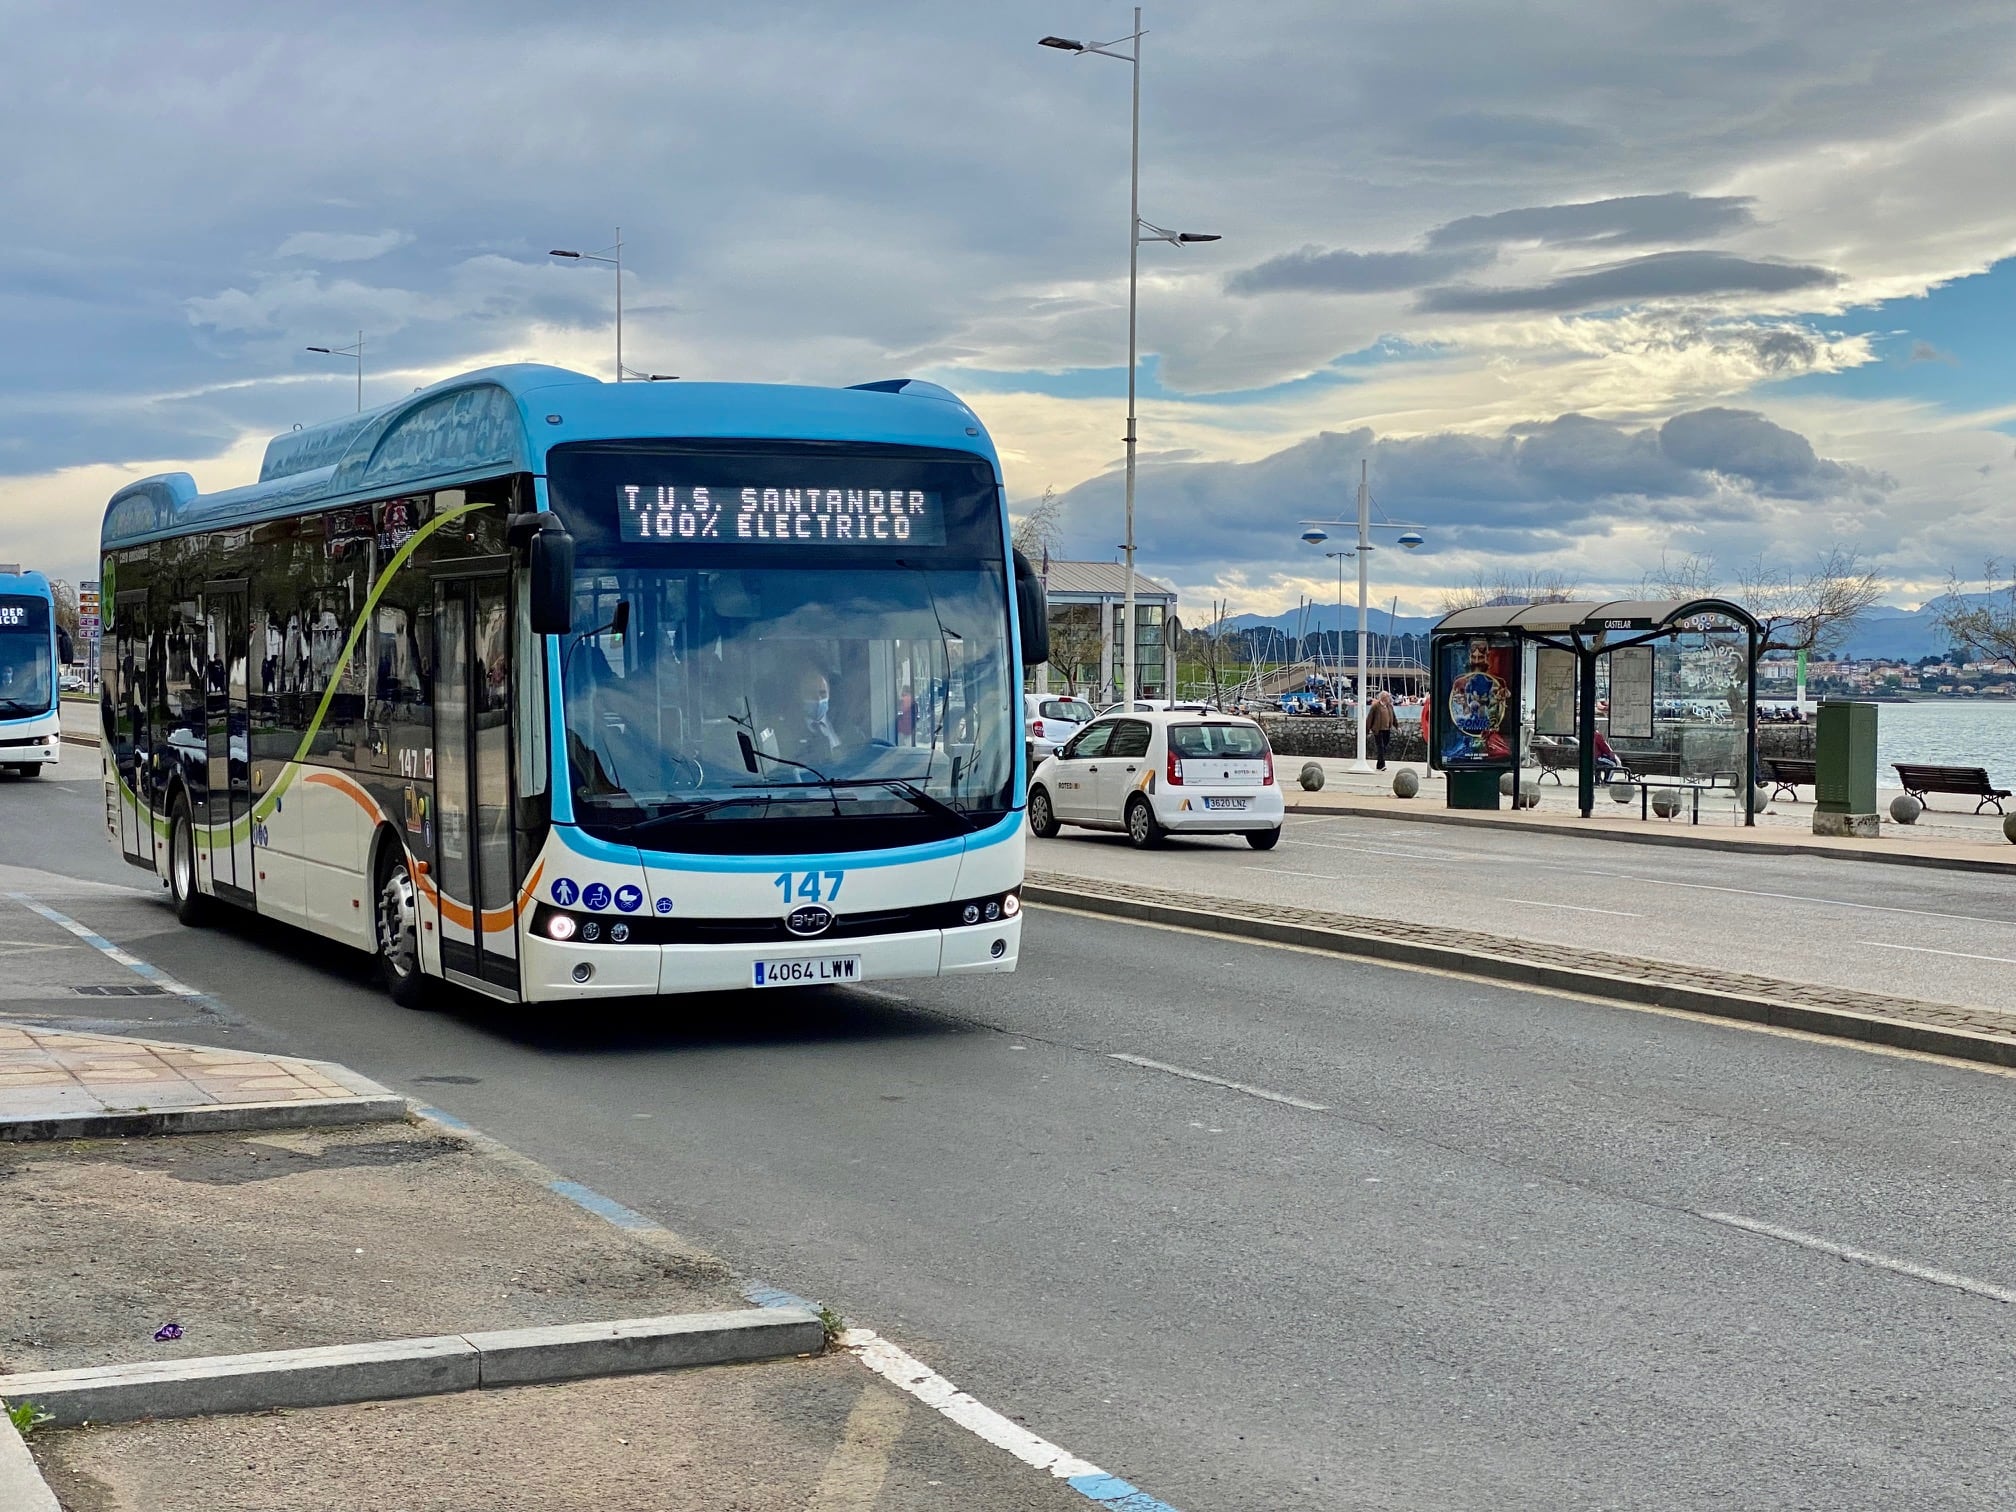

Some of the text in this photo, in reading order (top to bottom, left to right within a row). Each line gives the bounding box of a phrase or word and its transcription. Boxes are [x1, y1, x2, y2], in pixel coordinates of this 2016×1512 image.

[624, 486, 925, 514] T.U.S. SANTANDER
[640, 512, 910, 539] 100% ELECTRICO
[1604, 620, 1631, 629] CASTELAR
[1457, 718, 1490, 728] SONIC
[398, 748, 418, 778] 147
[1210, 799, 1247, 808] 3620 LNZ
[774, 870, 844, 904] 147
[791, 912, 828, 928] BYD
[768, 959, 854, 982] 4064 LWW
